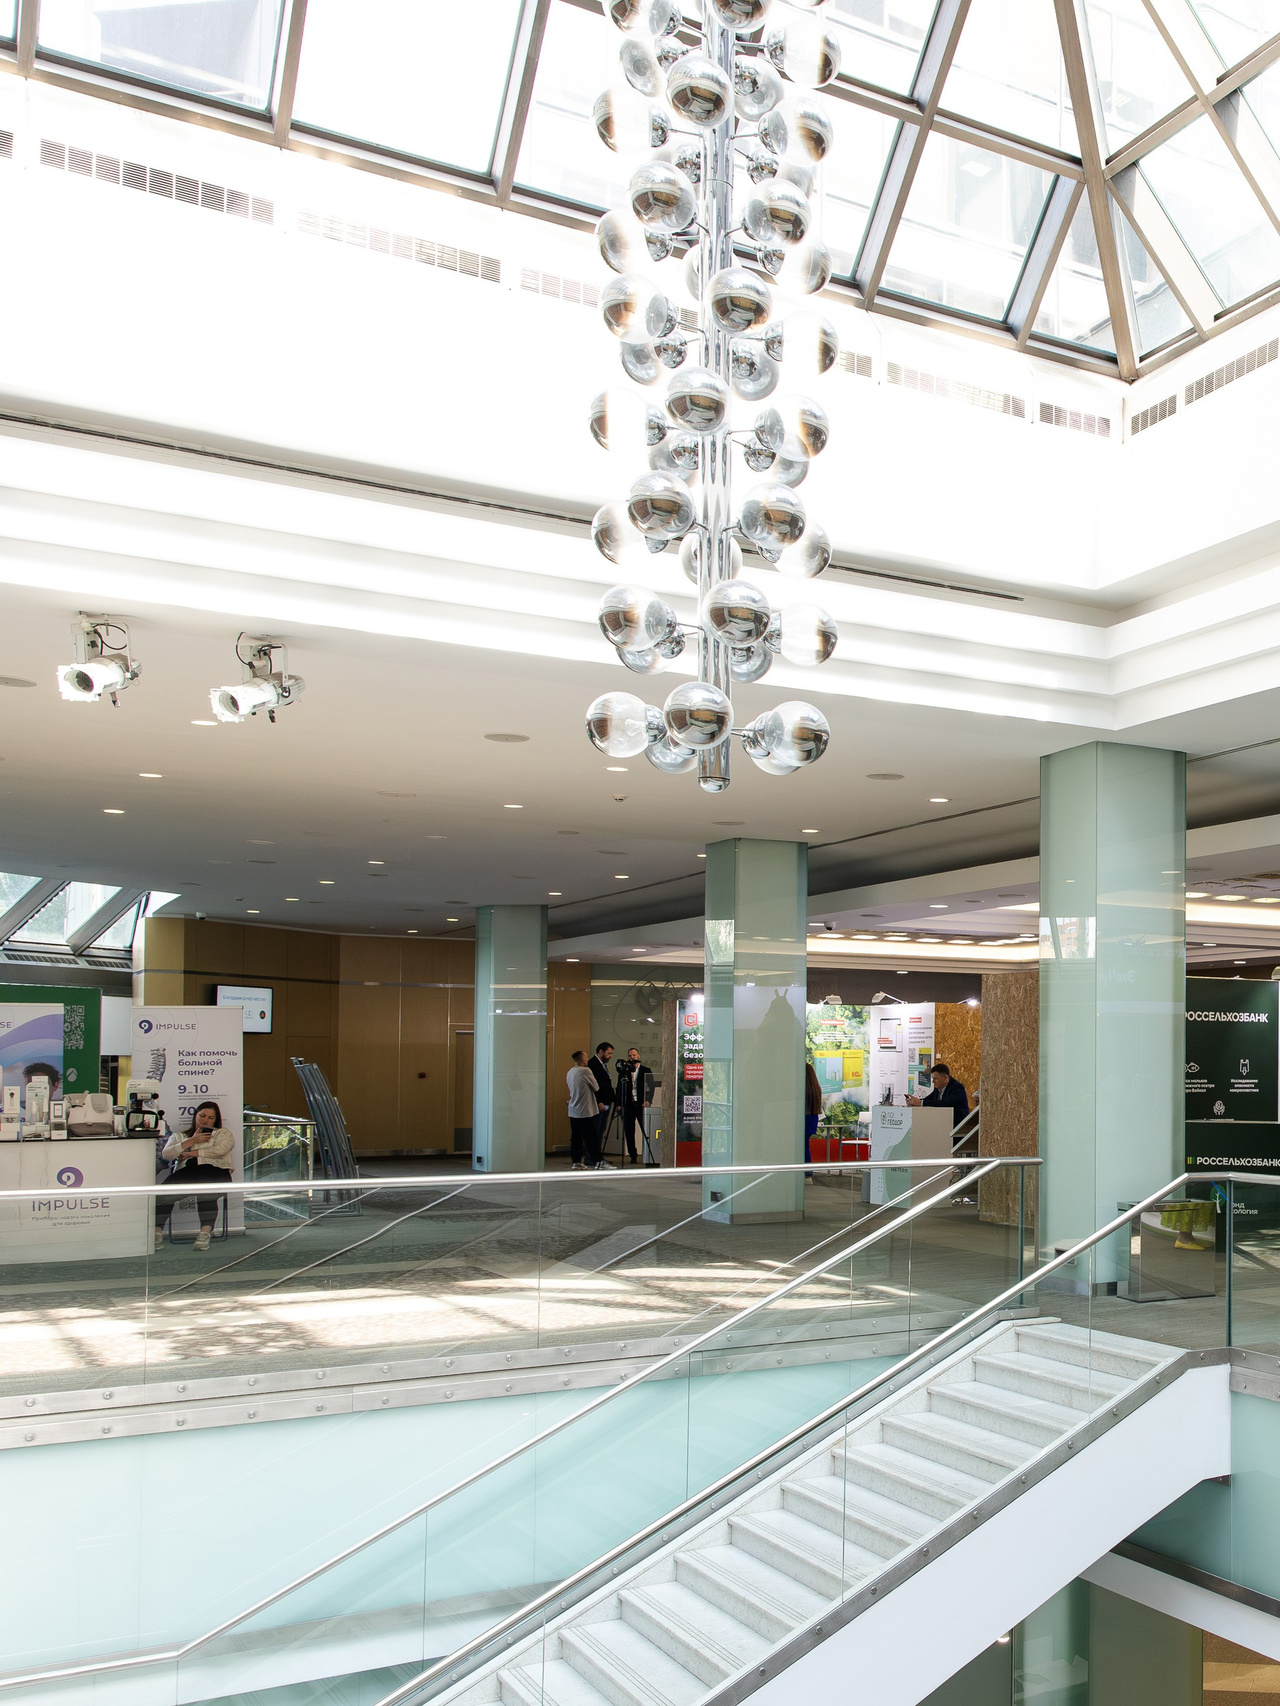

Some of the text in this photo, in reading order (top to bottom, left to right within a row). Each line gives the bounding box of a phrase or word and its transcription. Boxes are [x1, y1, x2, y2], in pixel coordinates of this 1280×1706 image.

[155, 1023, 197, 1031] IMPULSE
[178, 1058, 223, 1067] больной
[178, 1068, 215, 1076] спине?
[32, 1197, 110, 1212] IMPULSE
